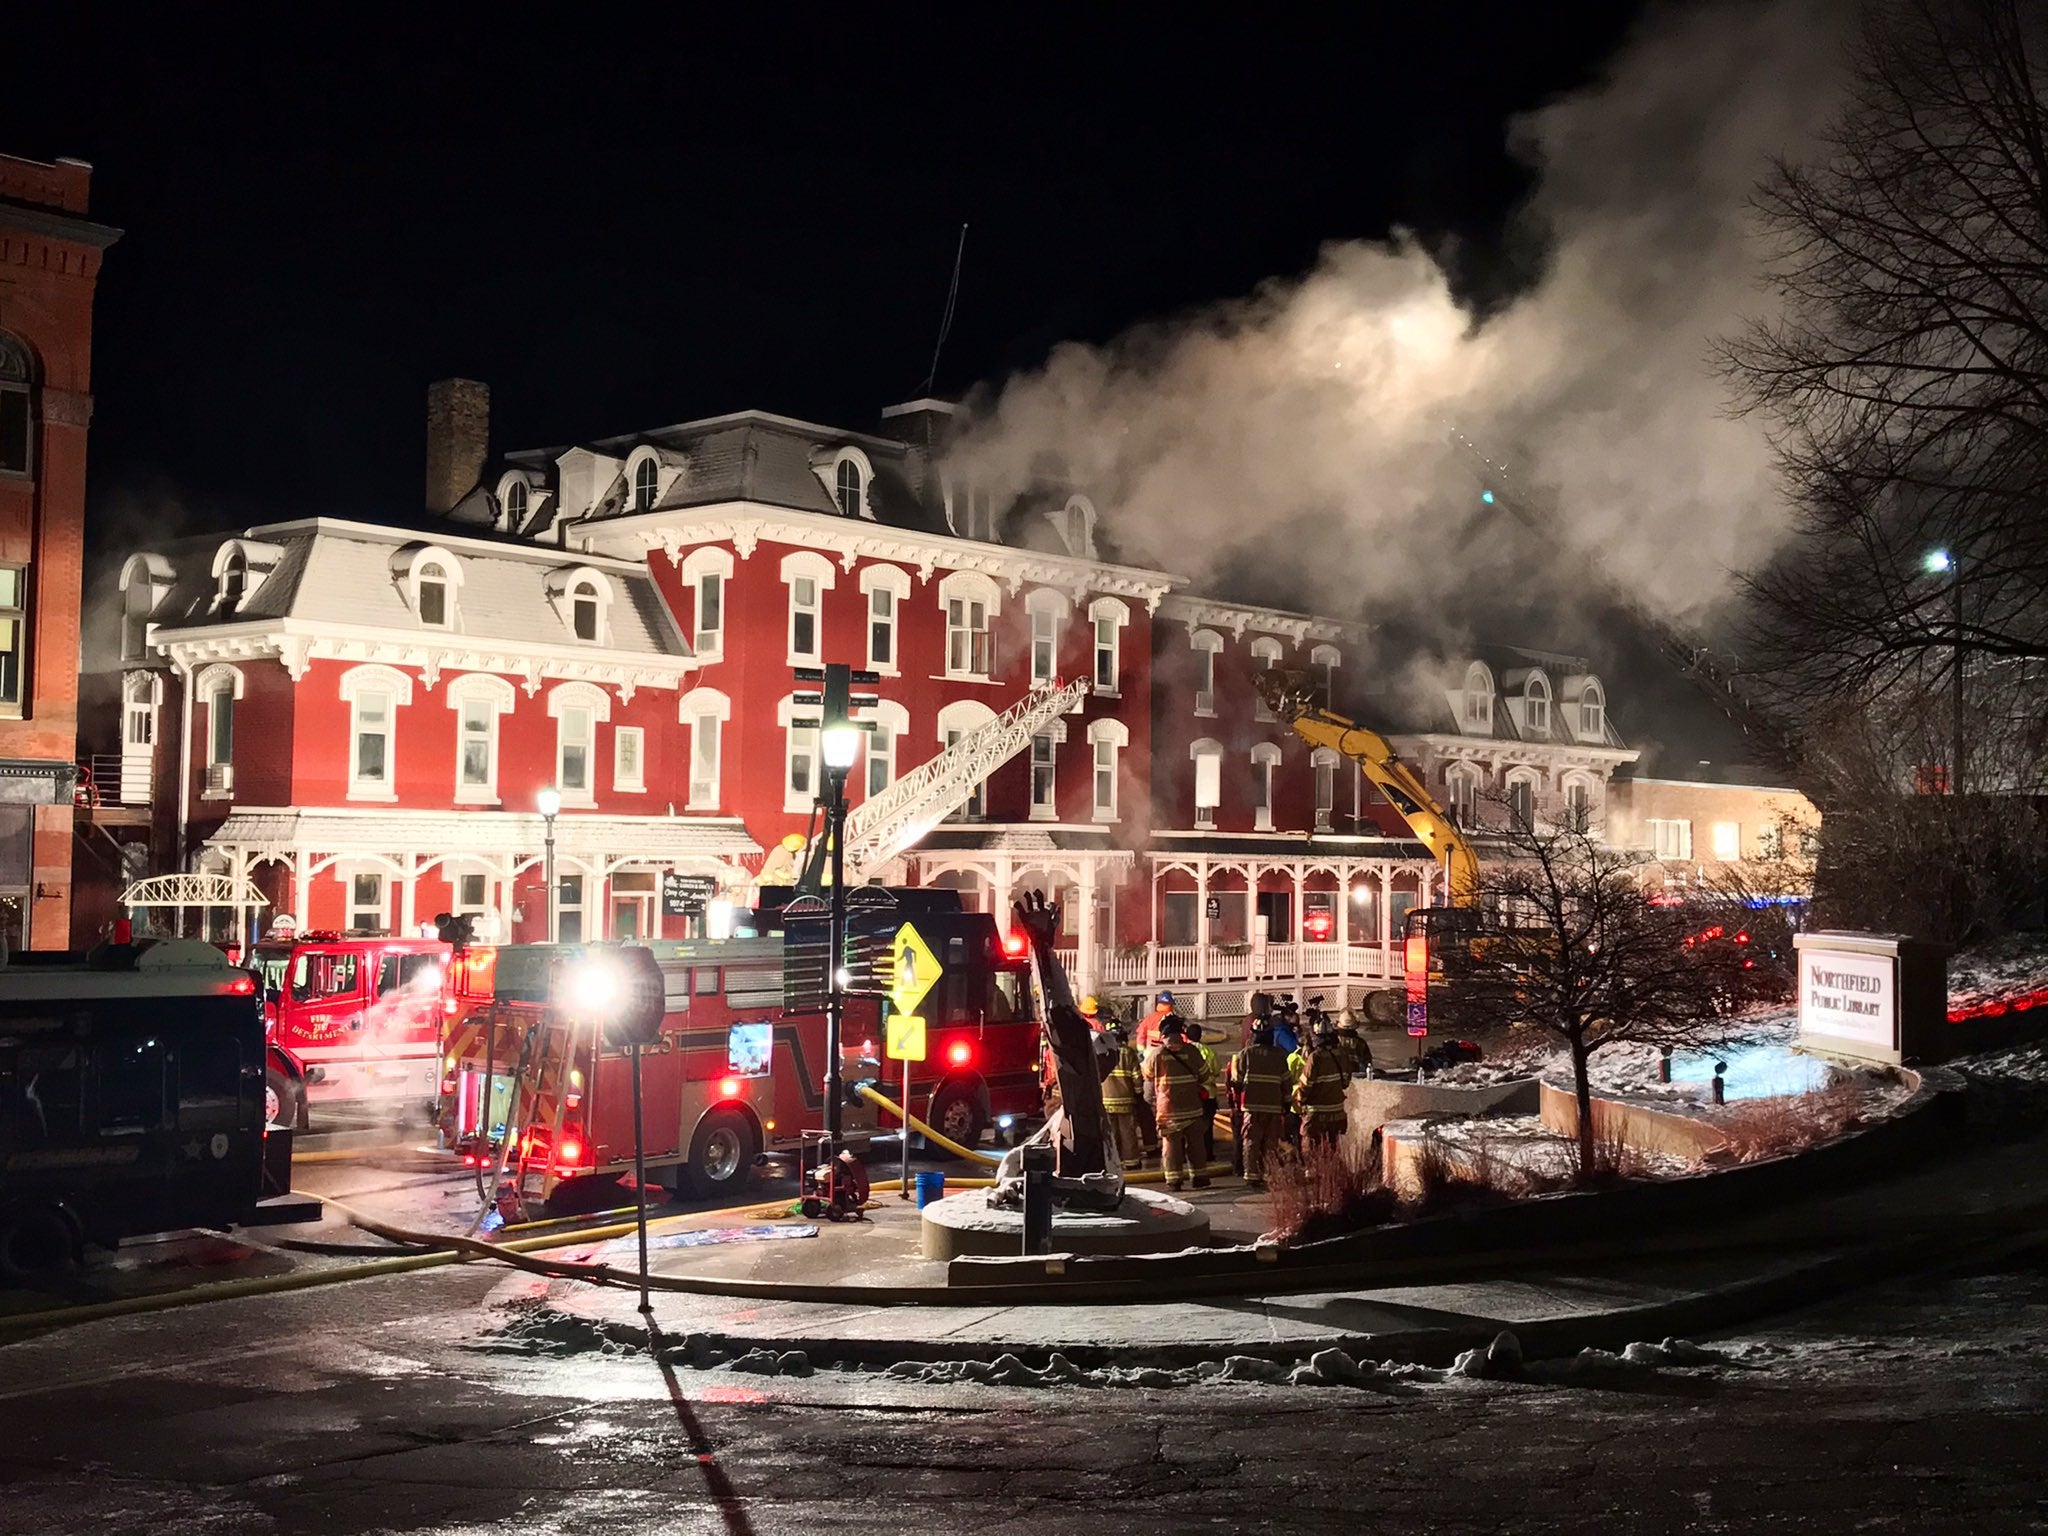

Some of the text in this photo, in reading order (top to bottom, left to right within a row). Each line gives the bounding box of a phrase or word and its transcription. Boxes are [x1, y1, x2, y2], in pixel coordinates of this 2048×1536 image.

[1810, 965, 1881, 994] NORTHFIELD
[1811, 991, 1881, 1017] PUBLIC LIBRARY
[309, 1014, 333, 1023] FIRE
[291, 1023, 350, 1041] DEPARTMENT
